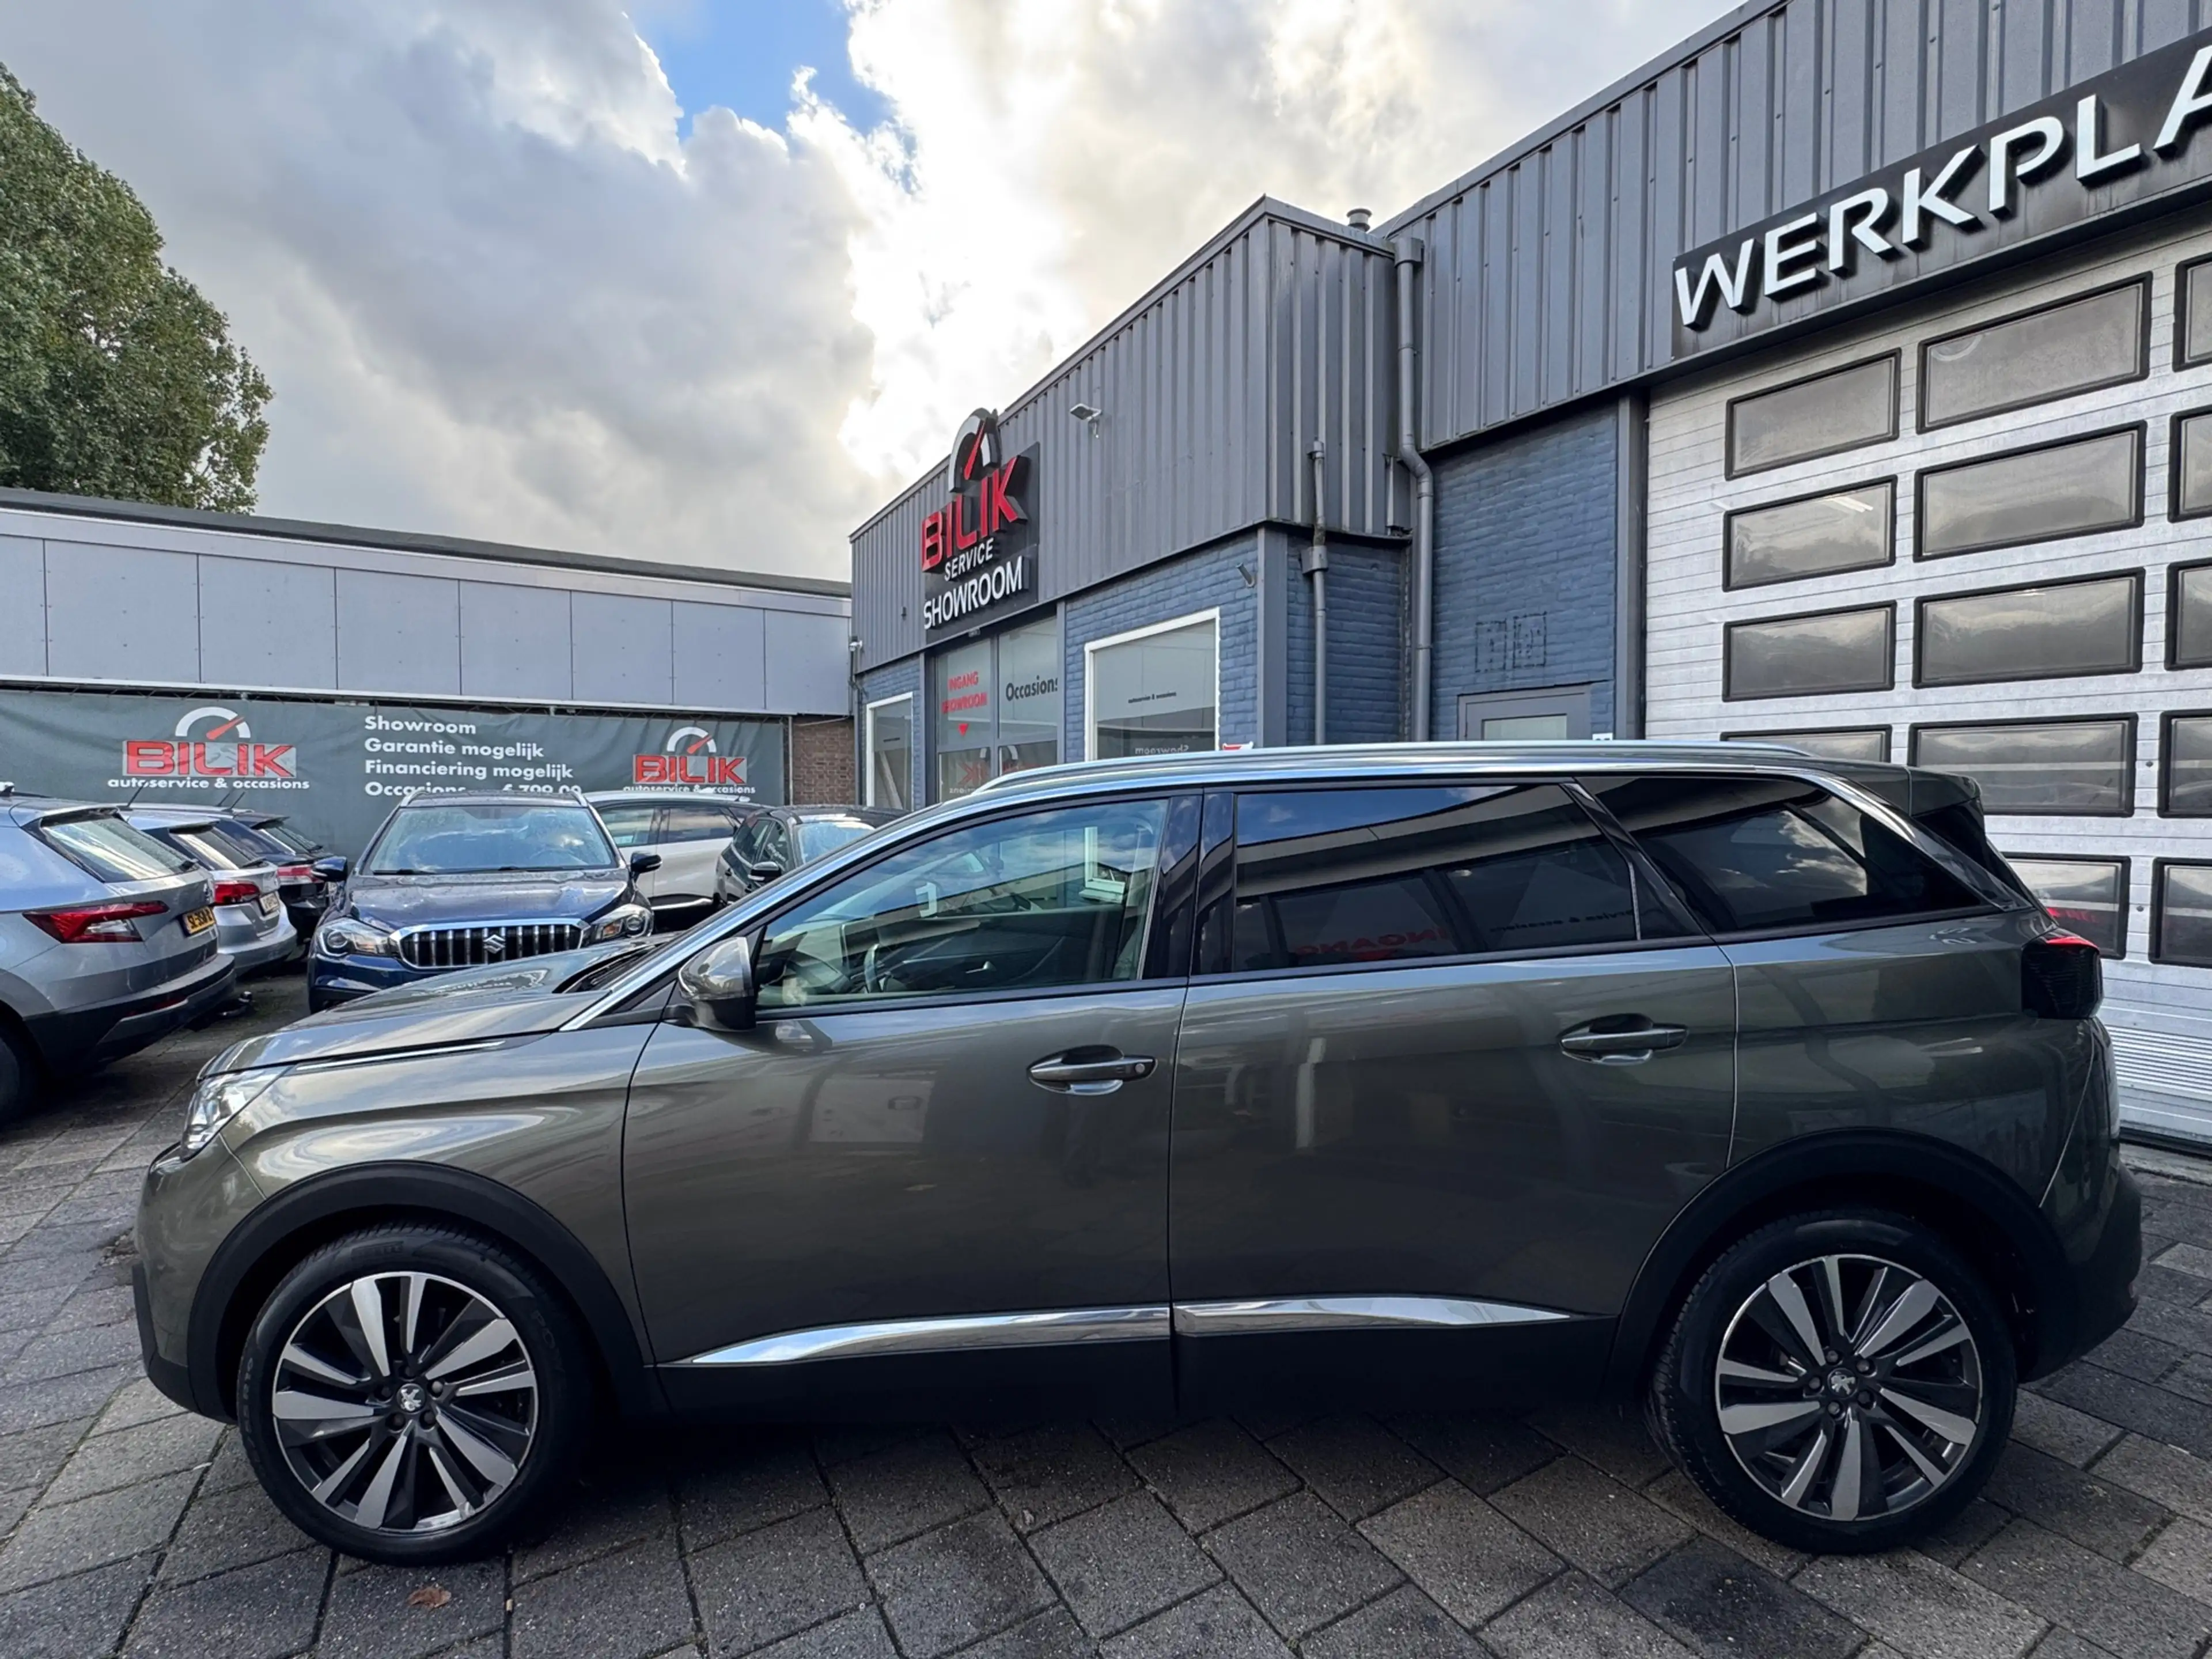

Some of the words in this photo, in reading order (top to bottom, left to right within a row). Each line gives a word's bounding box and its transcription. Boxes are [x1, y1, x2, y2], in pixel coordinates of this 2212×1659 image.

[922, 456, 1018, 571] BILIK
[945, 537, 994, 582] SERVICE
[924, 555, 1023, 630] SHOWROOM
[365, 715, 476, 734] Showroom
[127, 741, 296, 777] BILIK
[365, 737, 456, 755] Garantie
[462, 742, 544, 760] mogelijk
[365, 759, 487, 780] Financiering
[493, 764, 574, 782] mogelijk
[635, 755, 745, 784] BILIK
[108, 777, 209, 789] autoservice
[214, 778, 228, 789] &
[233, 778, 310, 789] occasions
[623, 783, 690, 793] autoservice
[707, 784, 756, 794] ccasions
